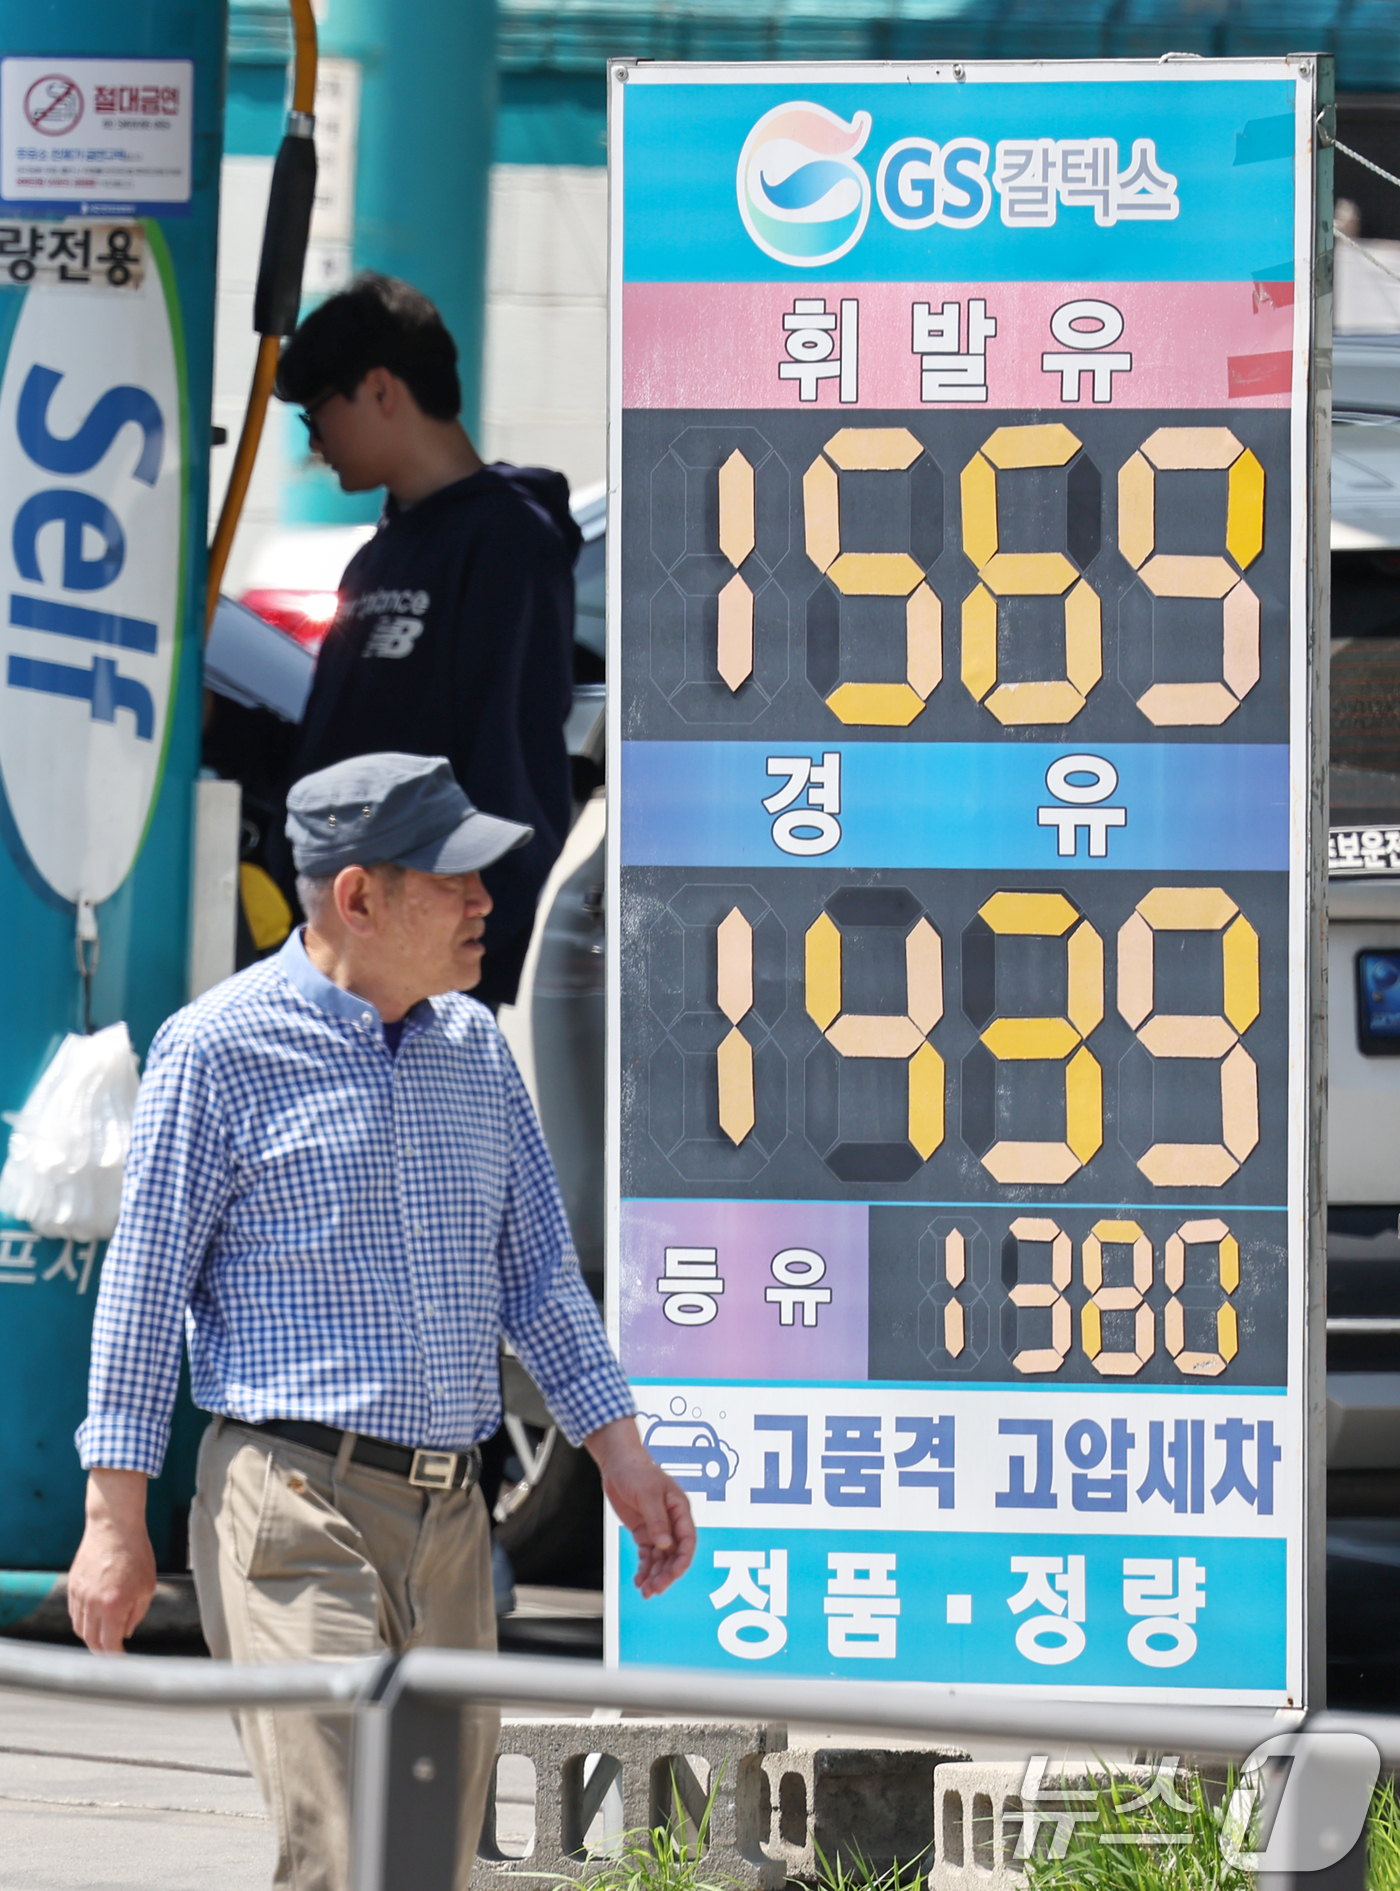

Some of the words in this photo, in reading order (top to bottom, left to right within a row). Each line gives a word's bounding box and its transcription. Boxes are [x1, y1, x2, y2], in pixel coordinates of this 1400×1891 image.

[778, 299, 1132, 403] 휘발유
[7, 362, 165, 742] Self
[717, 423, 1265, 726] 1569
[761, 752, 1127, 858] 경유
[717, 887, 1260, 1187] 1439
[657, 1246, 832, 1327] 등유
[945, 1218, 1240, 1376] 1380
[750, 1414, 956, 1509] 고품격
[995, 1417, 1282, 1516] 고압세차
